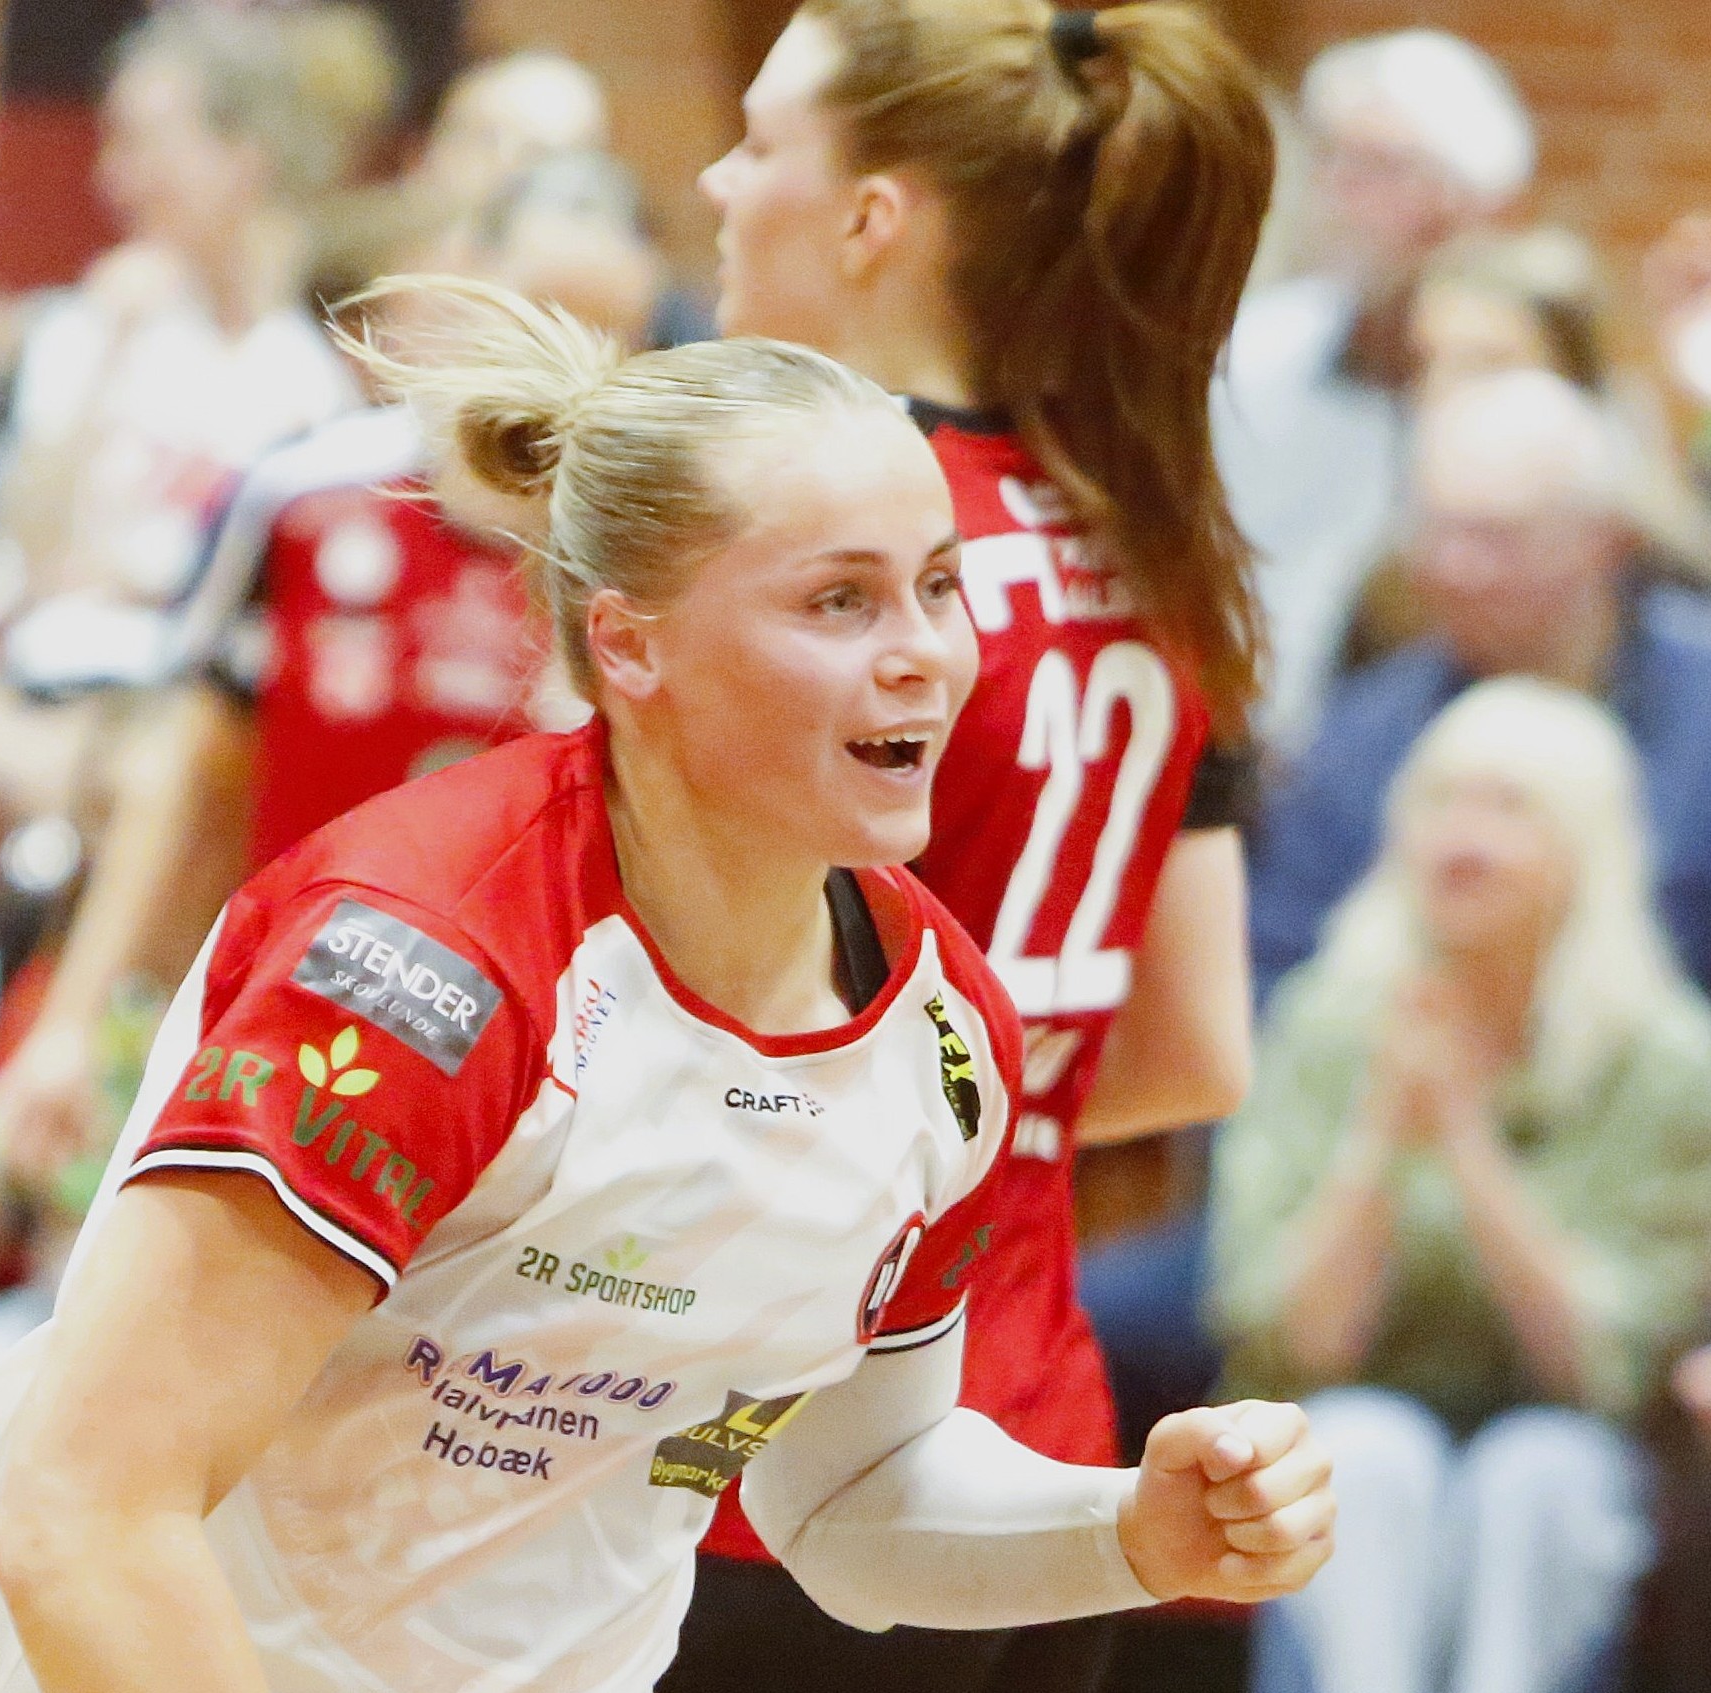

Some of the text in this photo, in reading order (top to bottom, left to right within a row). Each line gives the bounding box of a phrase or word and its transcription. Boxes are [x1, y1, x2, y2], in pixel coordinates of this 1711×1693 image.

[987, 640, 1175, 1018] 22
[328, 924, 478, 1031] STENDER
[185, 1046, 436, 1228] 2R VITAL
[724, 1086, 801, 1114] CRAFT
[516, 1245, 696, 1316] 2R SPORTSHOP
[404, 1335, 555, 1397] RMA
